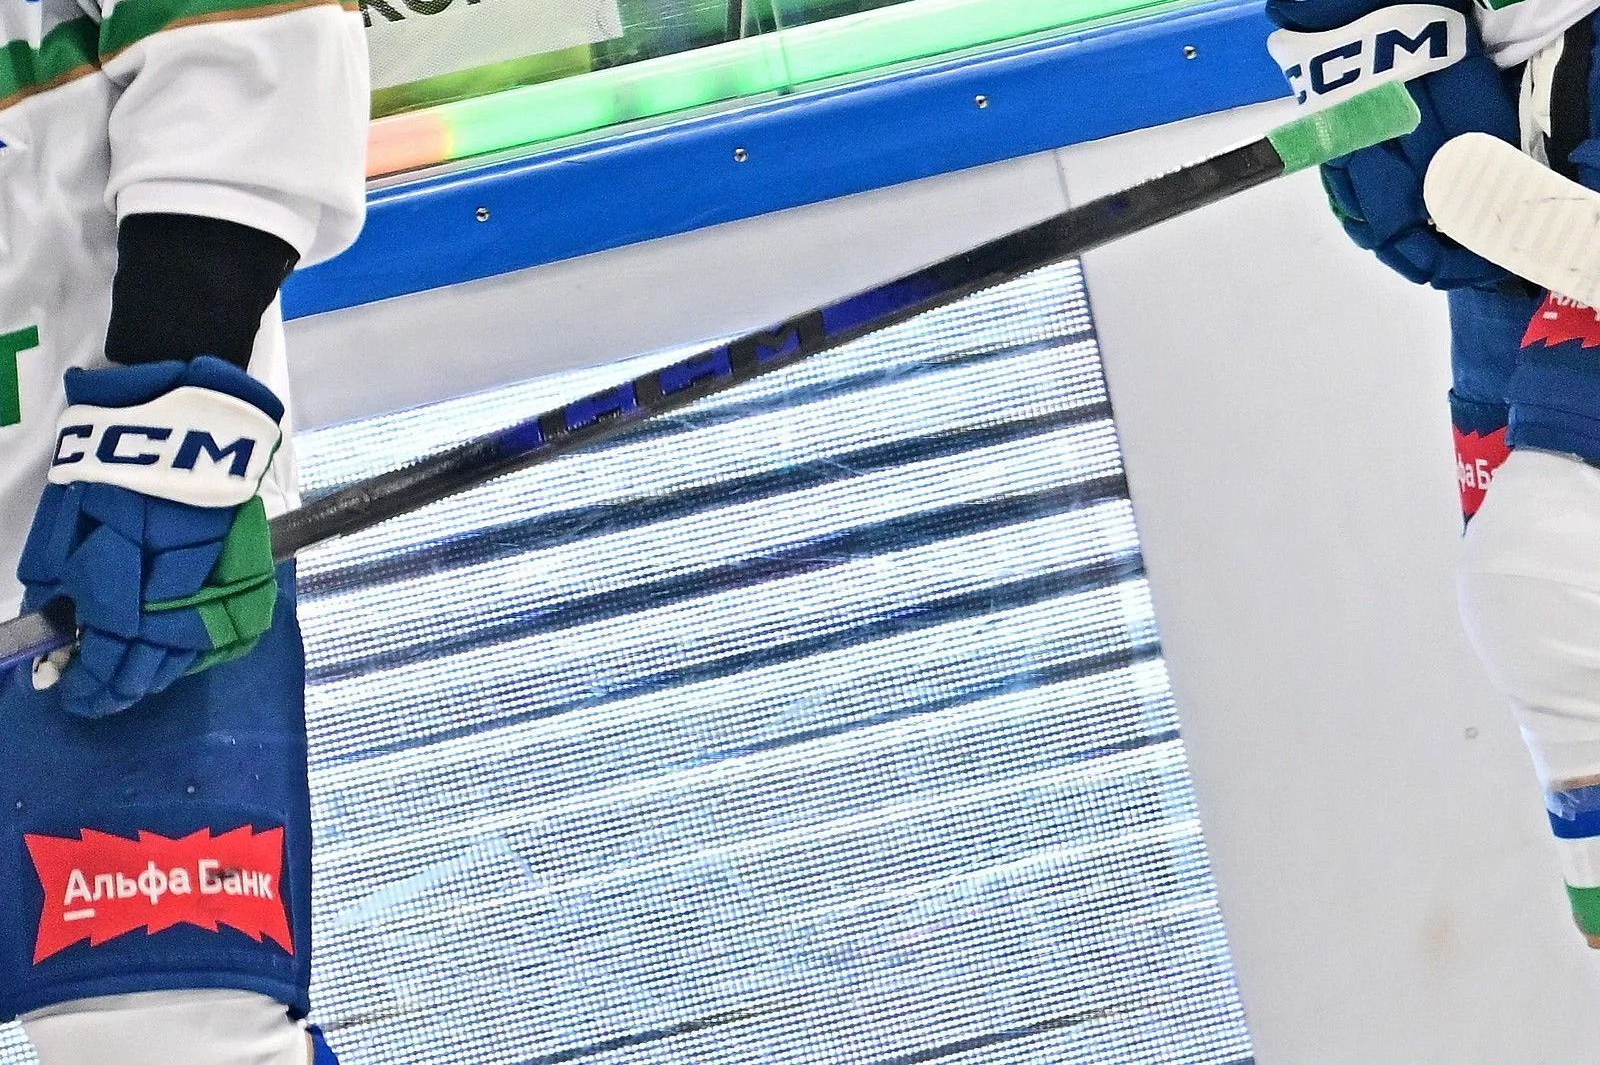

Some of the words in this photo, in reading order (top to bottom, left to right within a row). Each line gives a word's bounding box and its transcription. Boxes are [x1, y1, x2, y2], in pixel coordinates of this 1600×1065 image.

[52, 424, 256, 478] CCM
[63, 860, 192, 906] Альфа
[198, 858, 273, 901] Банк
